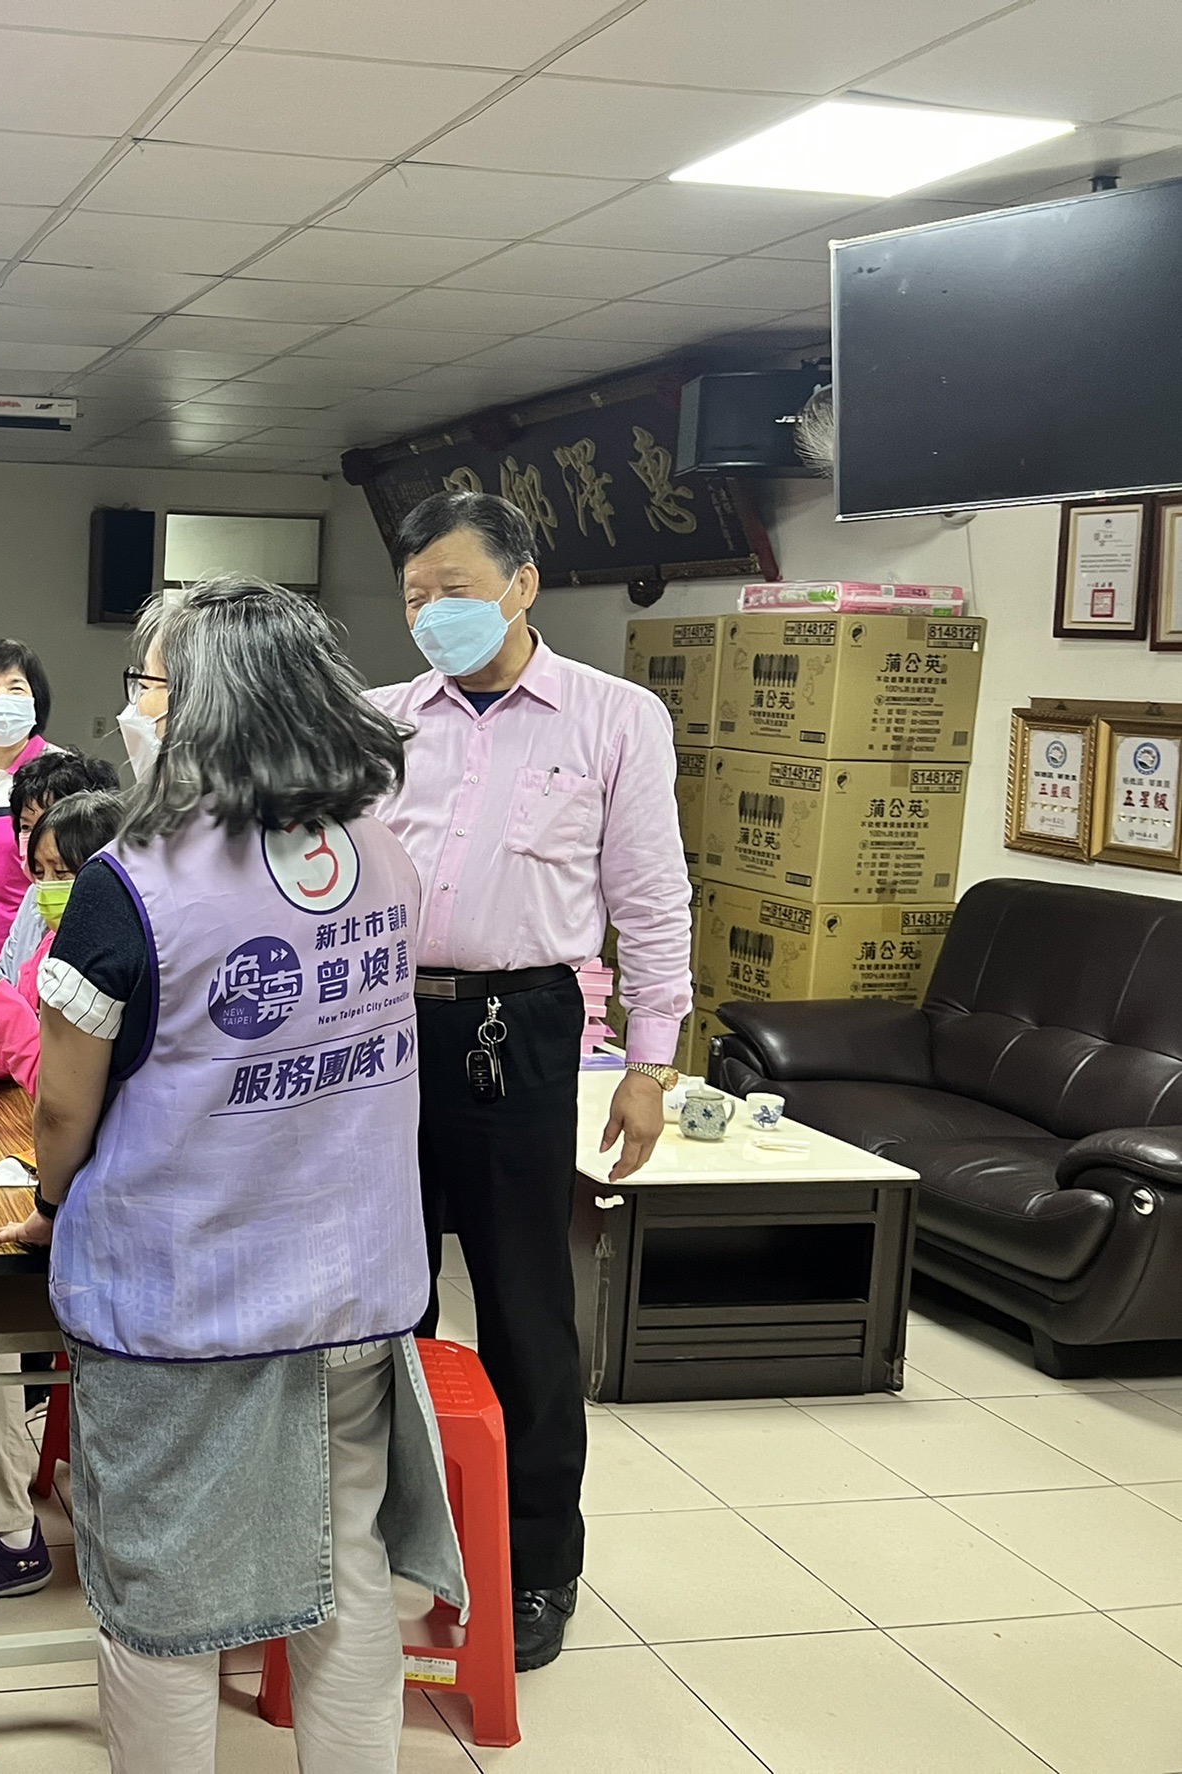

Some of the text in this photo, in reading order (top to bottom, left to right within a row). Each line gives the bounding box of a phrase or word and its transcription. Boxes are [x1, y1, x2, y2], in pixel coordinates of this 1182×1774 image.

[928, 625, 978, 640] 814812F
[880, 652, 948, 674] 蒲公英
[750, 689, 796, 710] 蒲公英
[911, 771, 962, 784] 814812F
[864, 798, 929, 819] 蒲公英
[314, 904, 407, 951] 新北市議員
[855, 940, 922, 961] 蒲公英
[317, 939, 409, 1004] 曾煥嘉
[222, 1007, 245, 1017] NEW
[222, 1015, 253, 1026] TAIPEI
[318, 1015, 337, 1025] New
[339, 1008, 364, 1020] Taipei
[366, 1002, 383, 1013] City
[226, 1034, 386, 1106] 服務團隊
